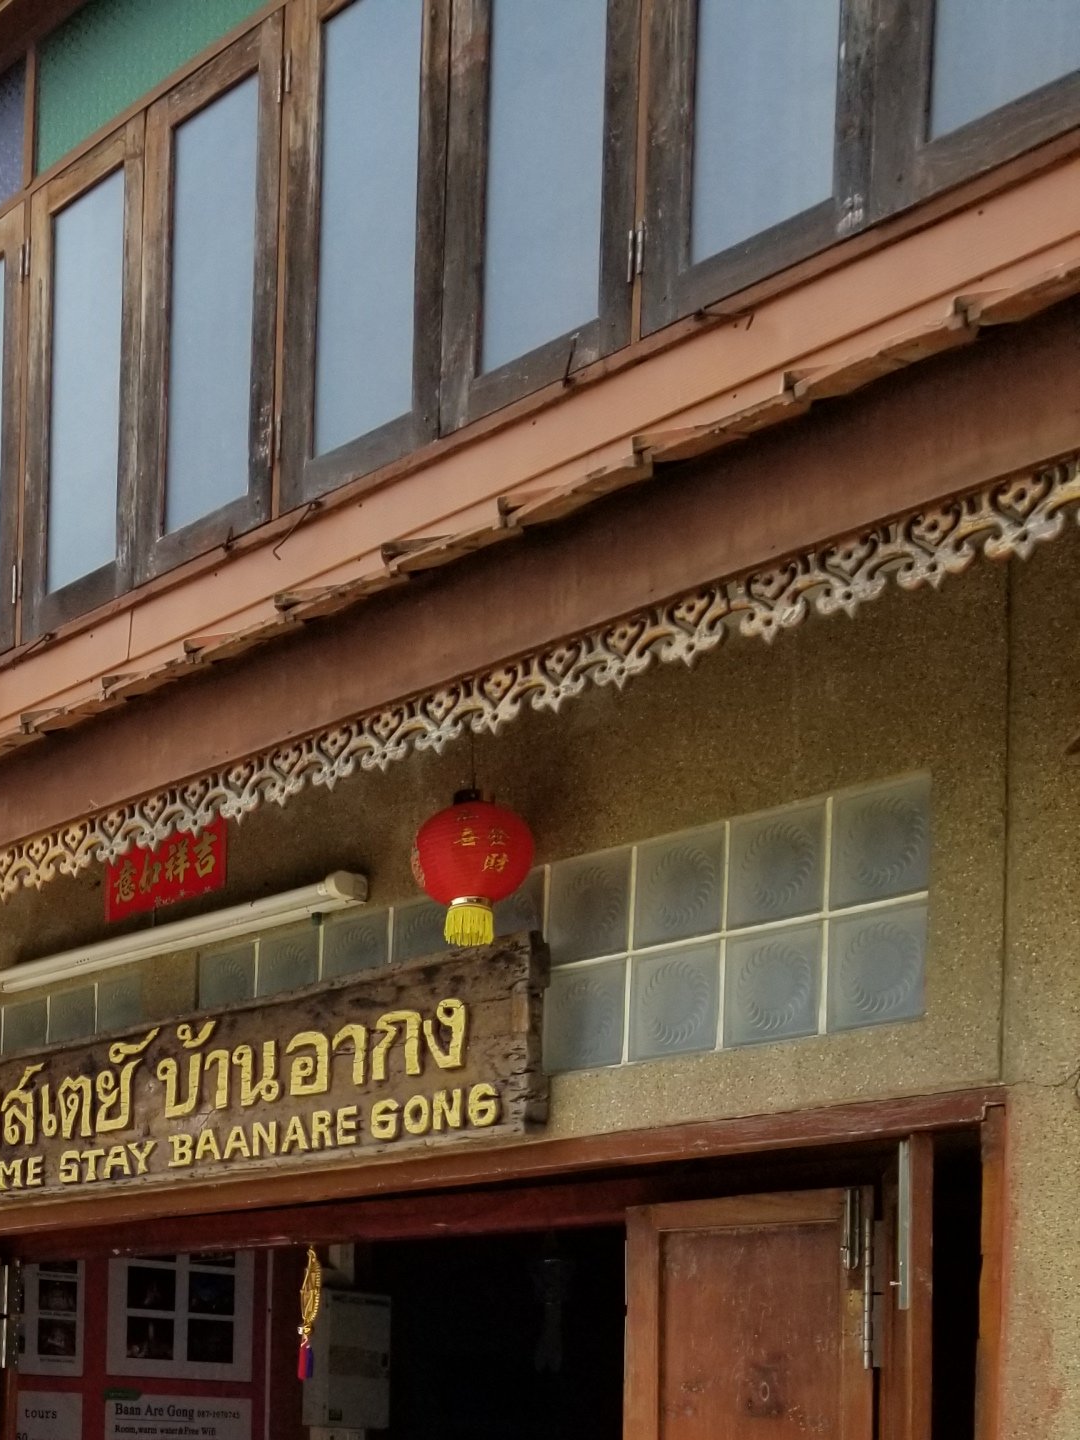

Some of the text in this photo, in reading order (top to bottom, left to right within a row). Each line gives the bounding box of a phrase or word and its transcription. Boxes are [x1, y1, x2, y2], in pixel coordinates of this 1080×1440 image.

[157, 999, 466, 1119] บ้านอากง
[59, 1140, 157, 1183] STAY
[371, 1083, 498, 1140] GONG
[25, 1408, 57, 1419] tours
[115, 1403, 141, 1416] Baan
[144, 1404, 164, 1417] Are
[167, 1405, 194, 1420] Gong
